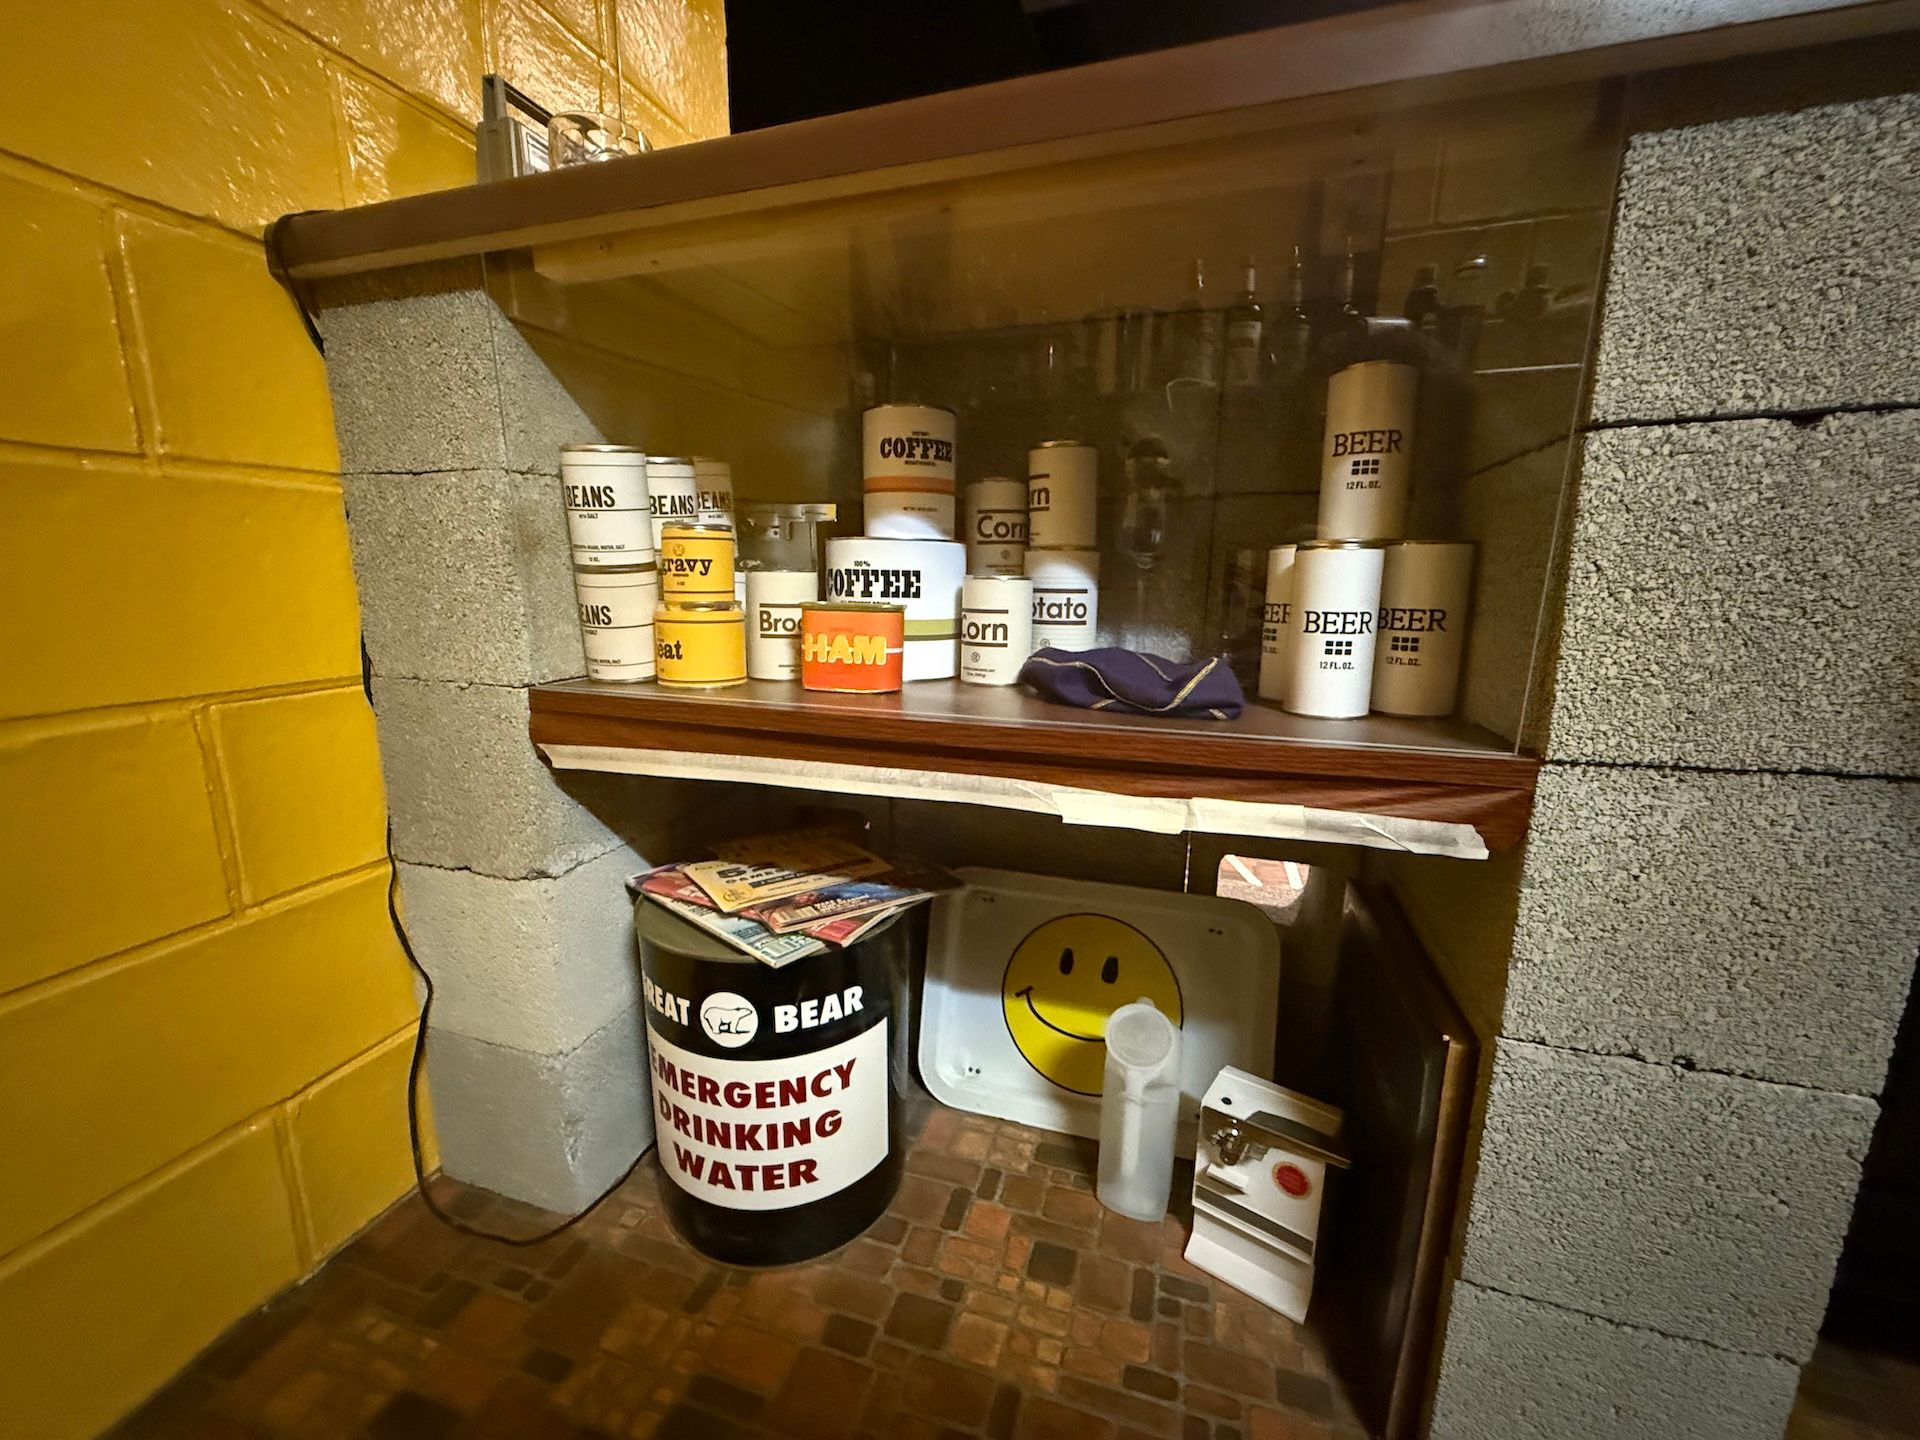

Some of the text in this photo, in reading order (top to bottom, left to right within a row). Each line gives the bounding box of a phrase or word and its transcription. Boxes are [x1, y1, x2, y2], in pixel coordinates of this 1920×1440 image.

[880, 437, 952, 463] COFFEE
[1332, 429, 1402, 457] BEER
[565, 485, 616, 508] BEANS
[1346, 480, 1381, 490] 12 FL. OZ.
[649, 494, 695, 515] BEANS
[1303, 610, 1373, 635] BEER
[1378, 608, 1447, 632] BEER
[803, 633, 887, 666] HAM
[1329, 662, 1341, 670] FL.
[1342, 662, 1355, 670] OZ.
[774, 985, 864, 1034] BEAR
[658, 1088, 843, 1151] DRINKING
[673, 1140, 819, 1192] WATER
